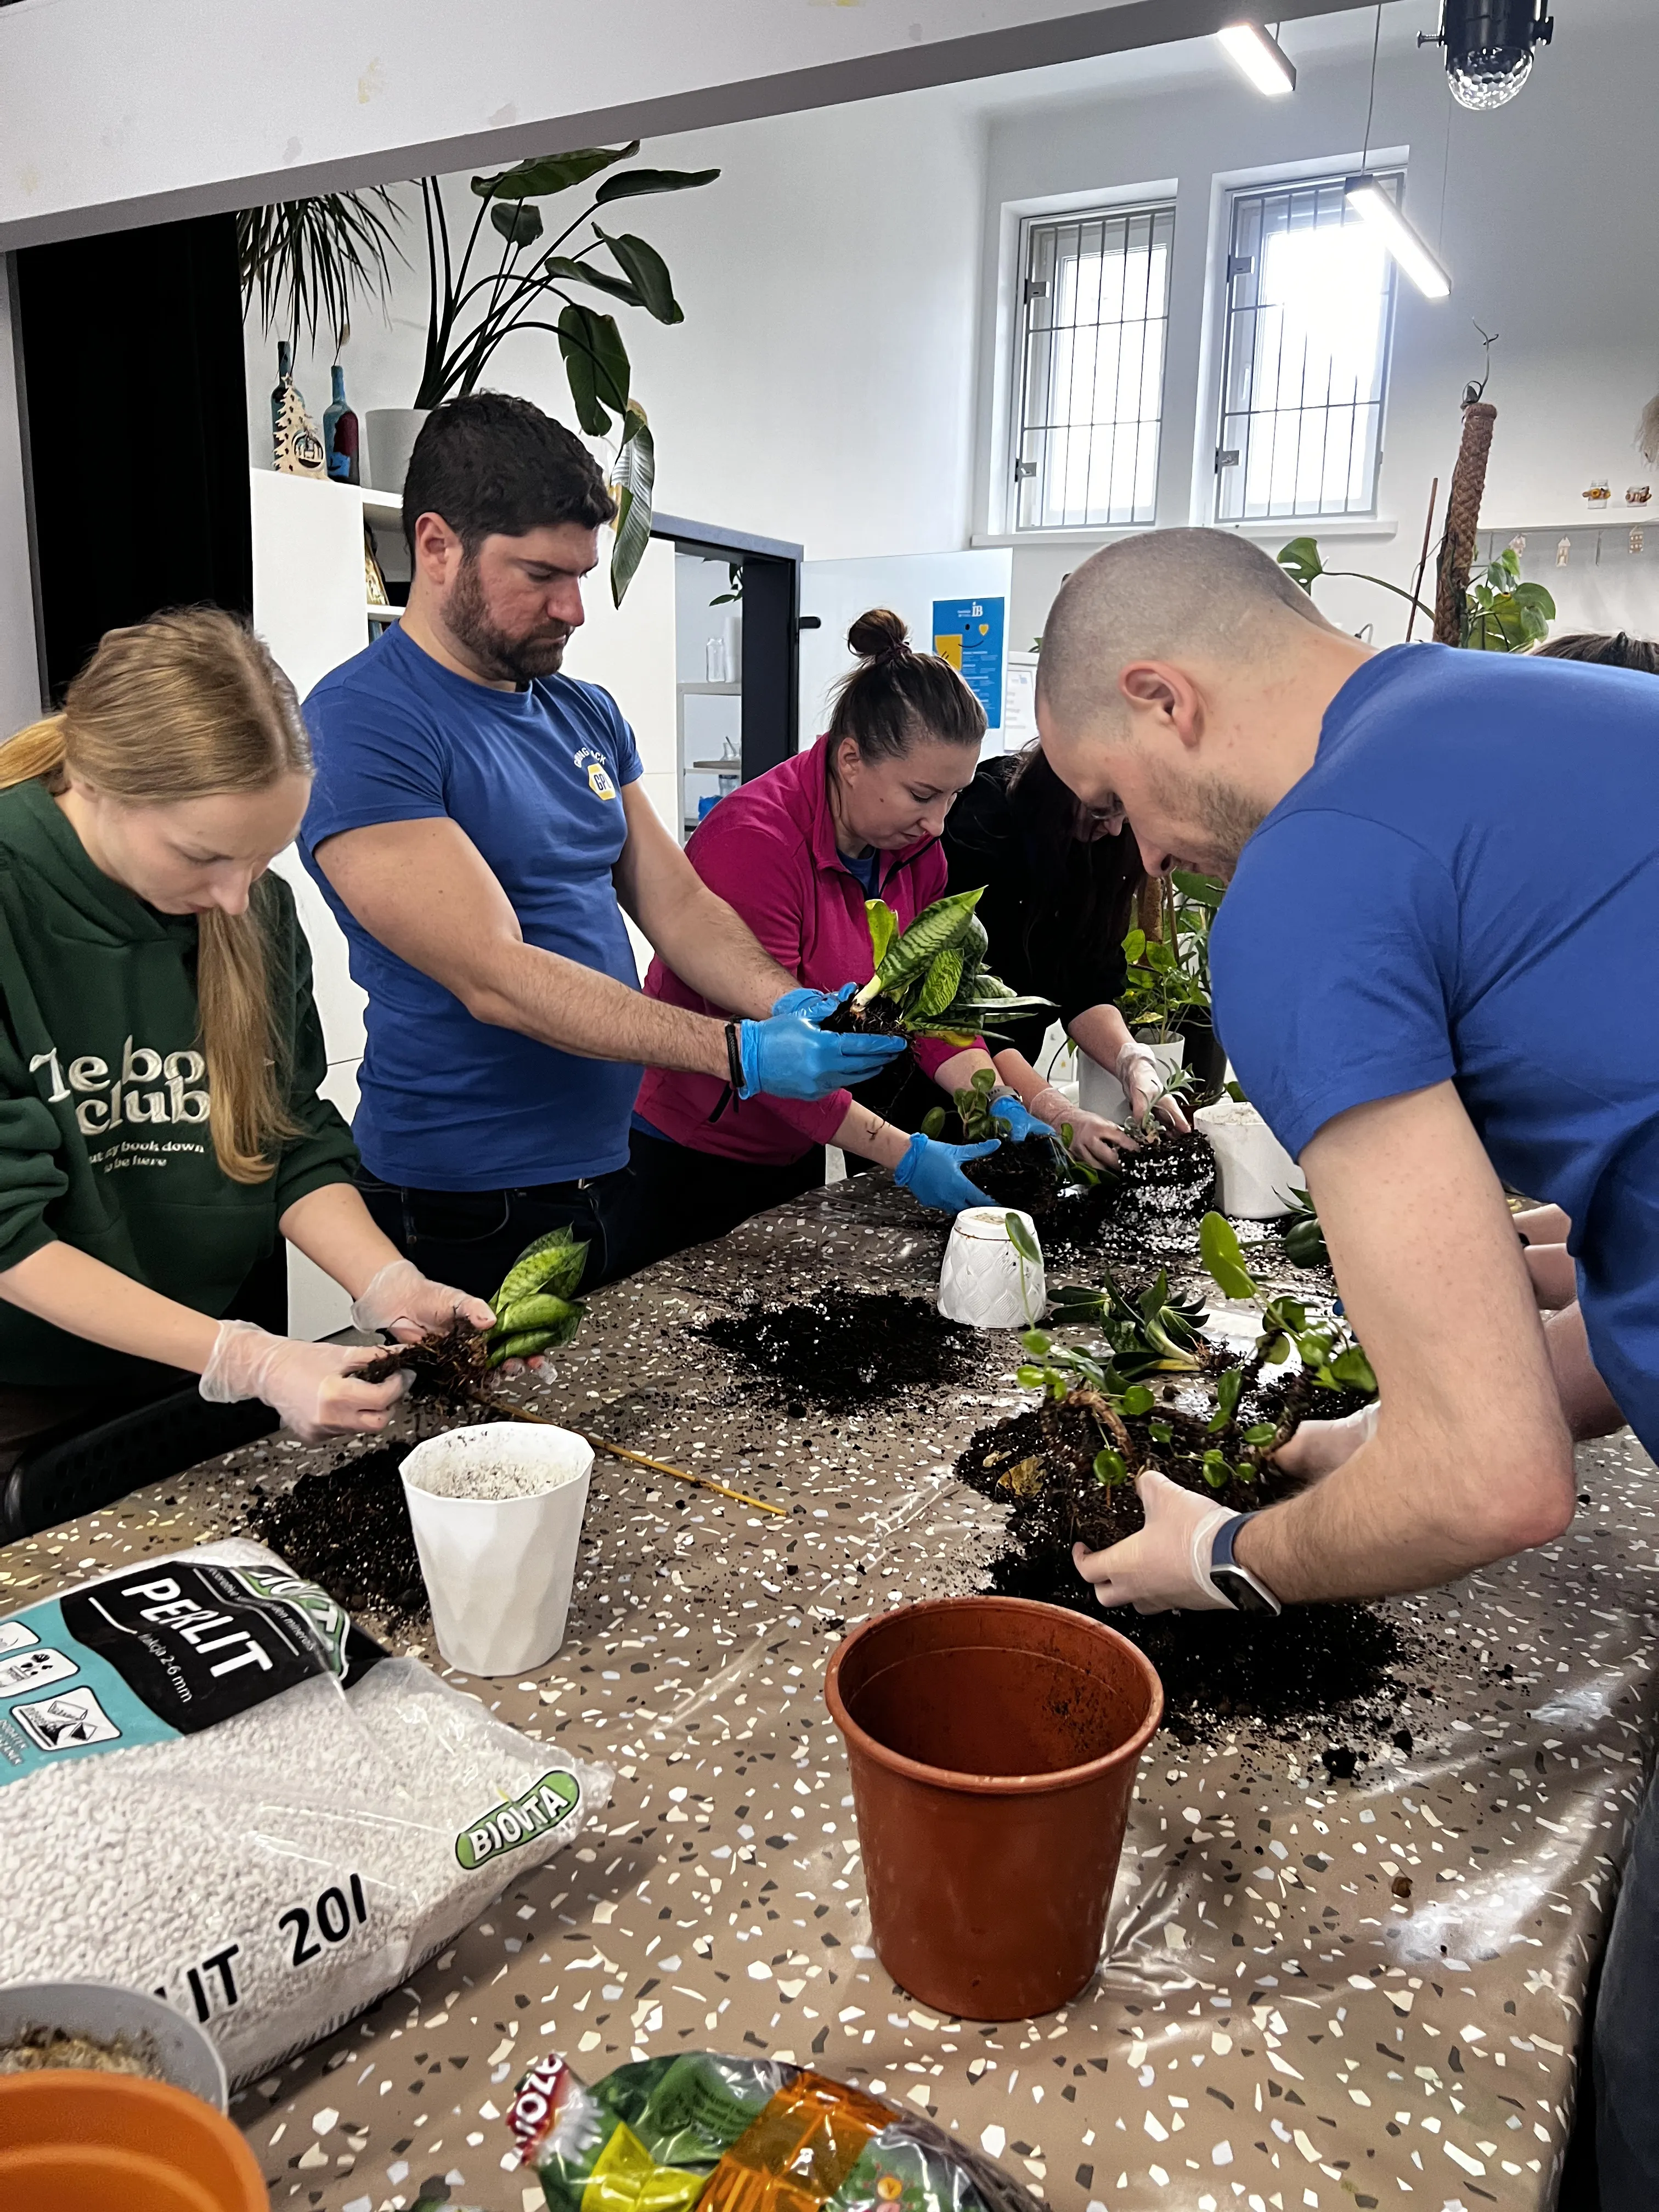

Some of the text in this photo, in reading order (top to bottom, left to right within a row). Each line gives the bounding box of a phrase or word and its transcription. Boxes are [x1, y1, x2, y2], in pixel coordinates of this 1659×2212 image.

[75, 1075, 211, 1136] club
[121, 1140, 159, 1153] book
[161, 1141, 205, 1153] down
[132, 1155, 167, 1167] here
[121, 1577, 273, 1678] PERLIT
[171, 1675, 193, 1703] mm
